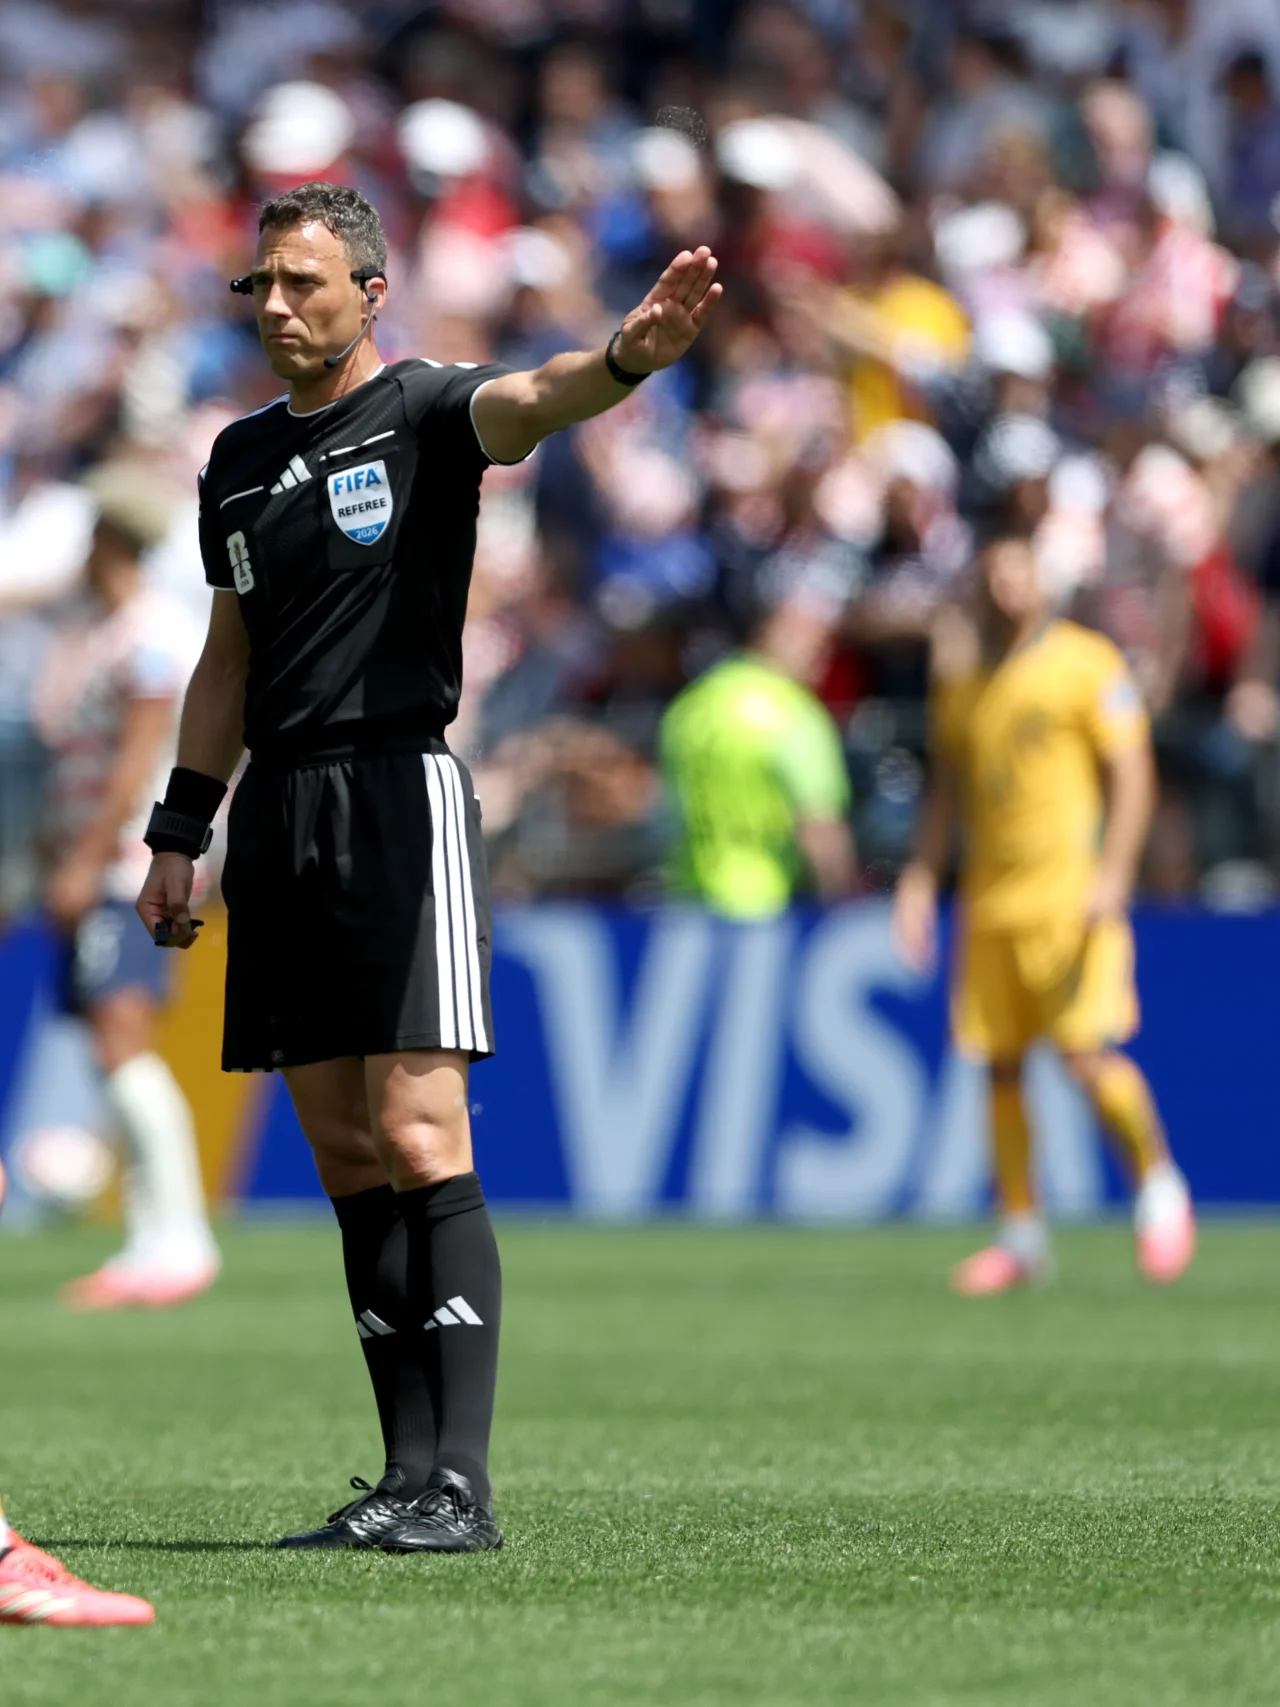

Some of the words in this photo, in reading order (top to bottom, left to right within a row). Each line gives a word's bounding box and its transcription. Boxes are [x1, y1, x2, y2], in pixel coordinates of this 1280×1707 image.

[333, 468, 382, 496] FIFA
[337, 497, 387, 518] REFEREE
[355, 526, 379, 540] 2026
